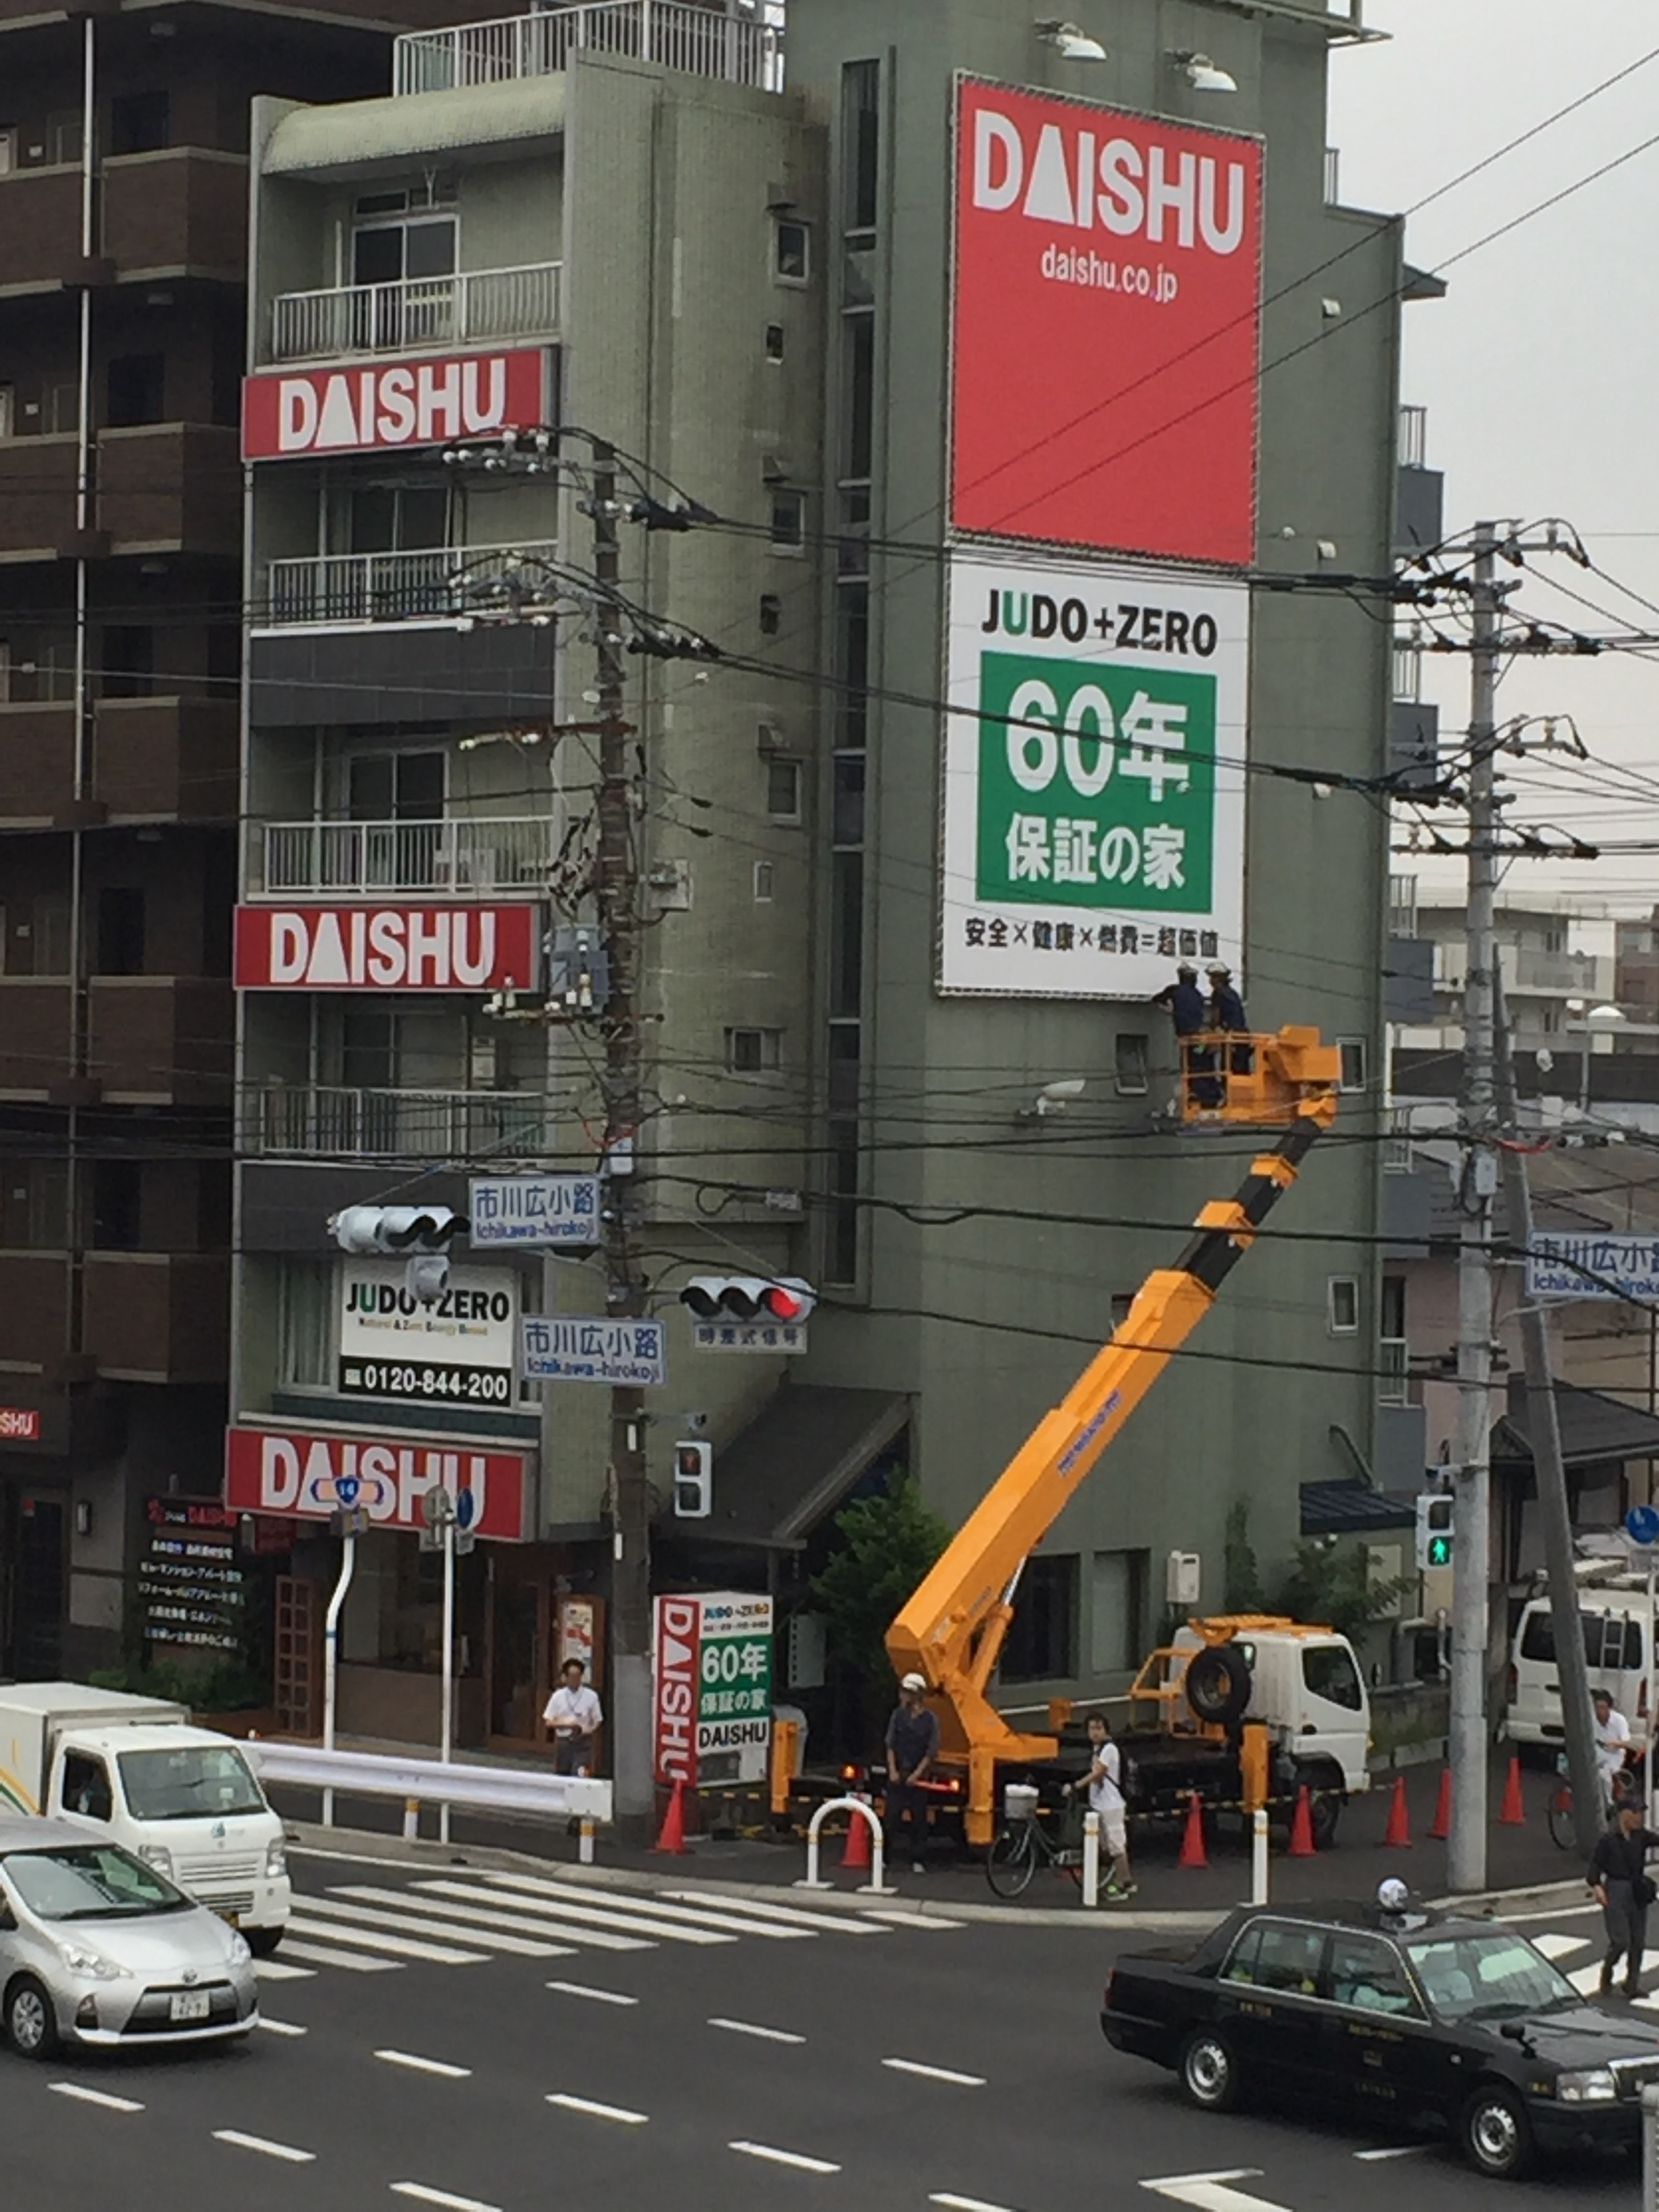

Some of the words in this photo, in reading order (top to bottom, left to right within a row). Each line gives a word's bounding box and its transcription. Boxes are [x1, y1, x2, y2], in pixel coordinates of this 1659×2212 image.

[973, 108, 1244, 255] DAISHU
[1042, 243, 1177, 303] daishu.co.jp
[279, 358, 506, 451] DAISHU
[981, 589, 1218, 657] JUDO+ZERO
[1006, 679, 1189, 802] 60年
[1005, 812, 1185, 890] 保証の家
[270, 912, 495, 985] DAISHU
[475, 1182, 594, 1218] 市川広小路
[476, 1220, 595, 1240] Ichikawa-hirokoji
[525, 1322, 658, 1359] 市川広小路
[528, 1358, 659, 1382] Ichikawa-hirokoji
[365, 1364, 508, 1400] 0120-844-200
[659, 1603, 694, 1781] DAISHU
[702, 1642, 768, 1683] 60年
[699, 1721, 766, 1748] DAISHU
